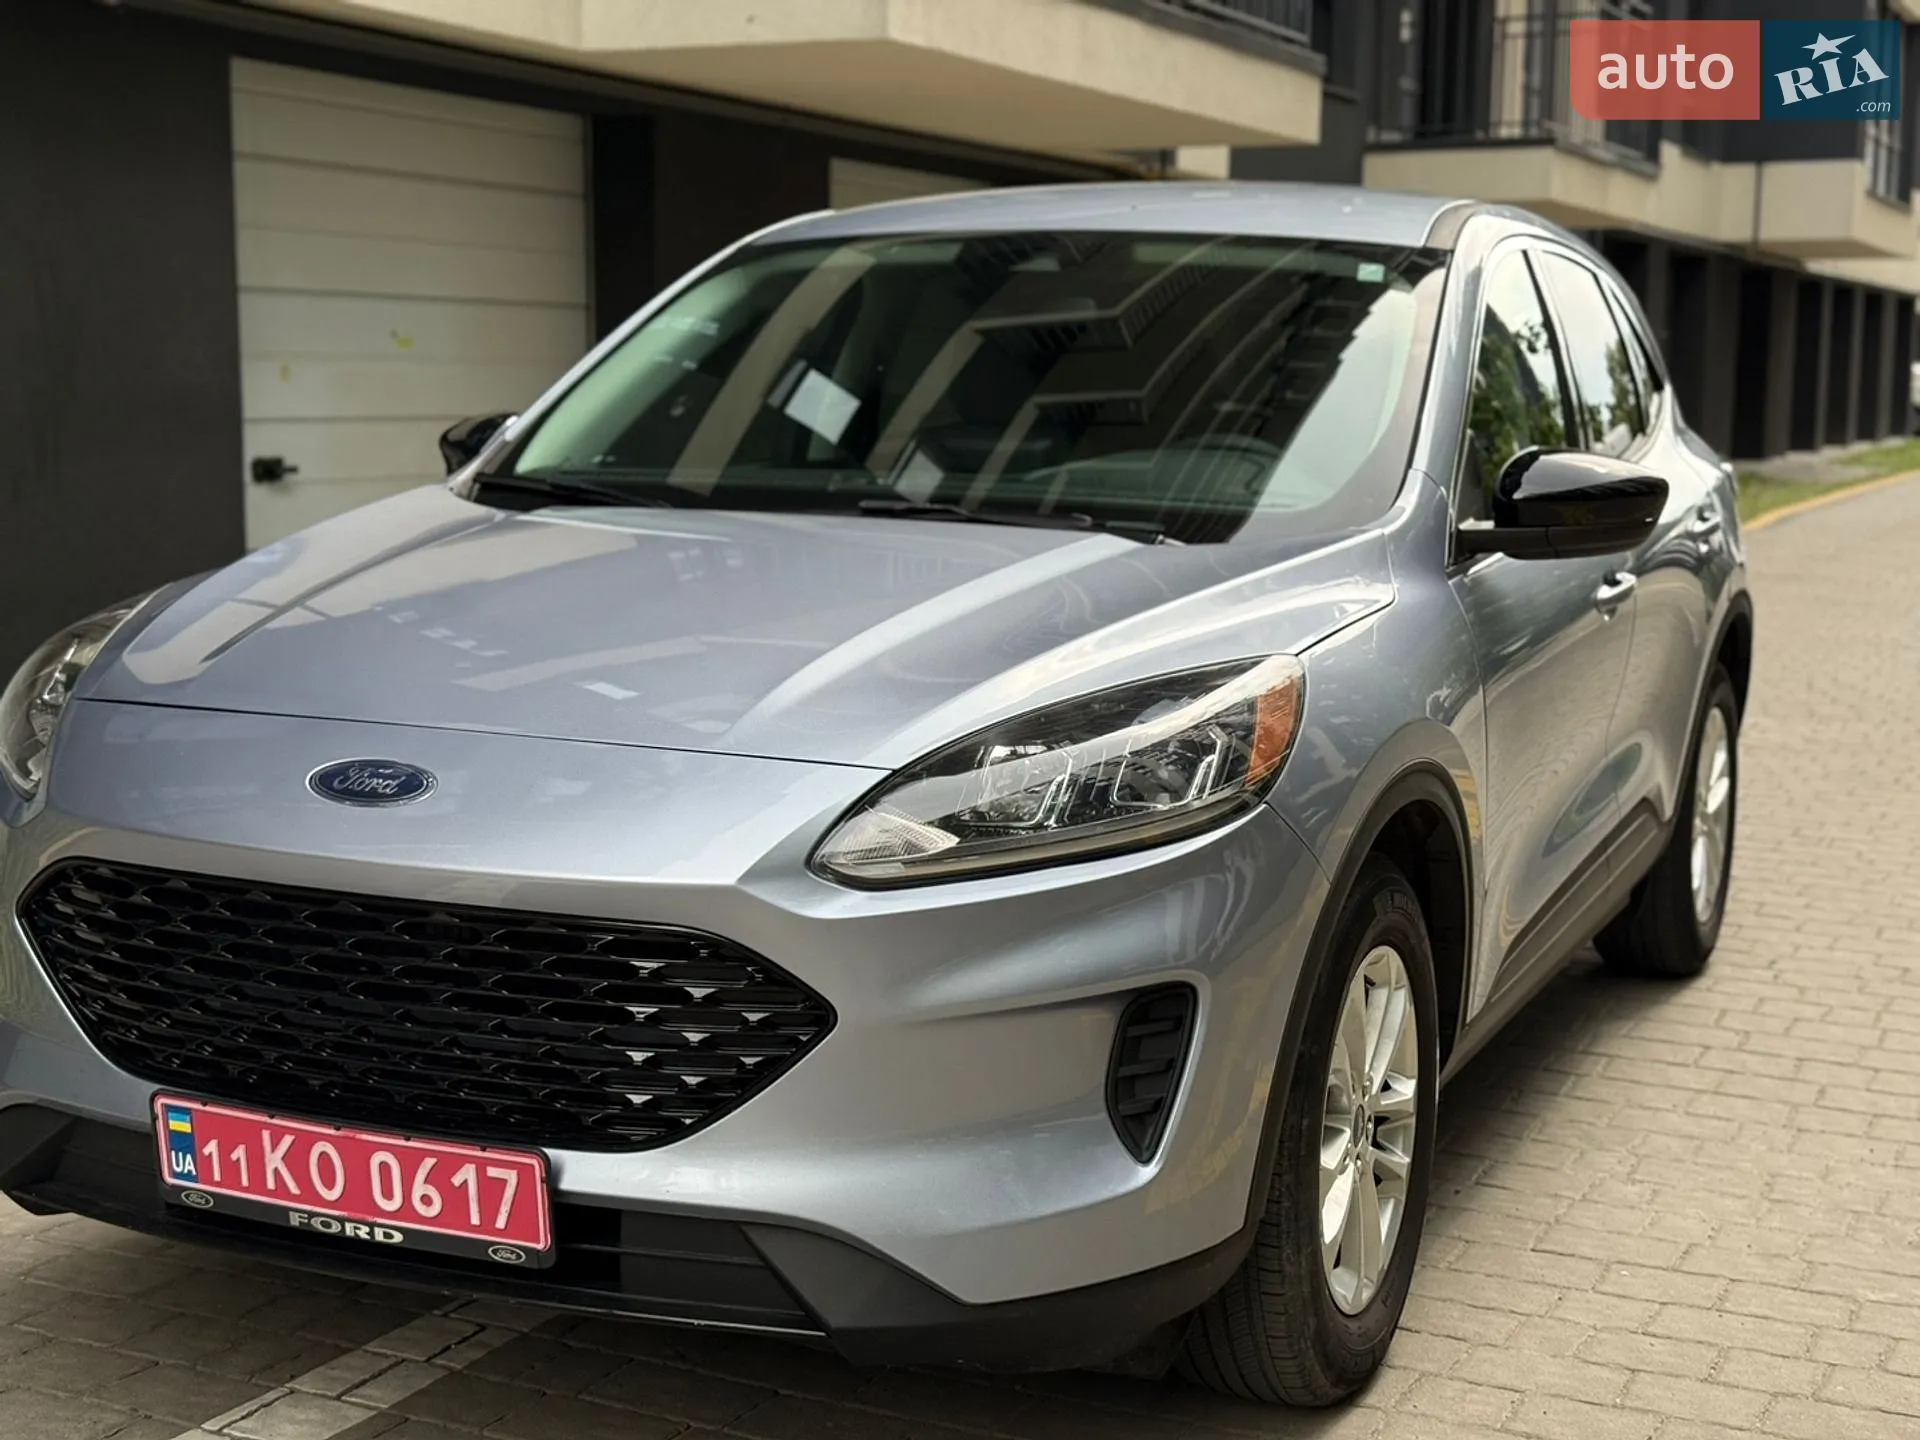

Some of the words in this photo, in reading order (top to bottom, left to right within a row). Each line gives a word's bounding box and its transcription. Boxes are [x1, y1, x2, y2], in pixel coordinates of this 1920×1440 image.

[333, 767, 407, 795] Ford
[171, 1149, 197, 1176] UA
[288, 1211, 404, 1244] FORD
